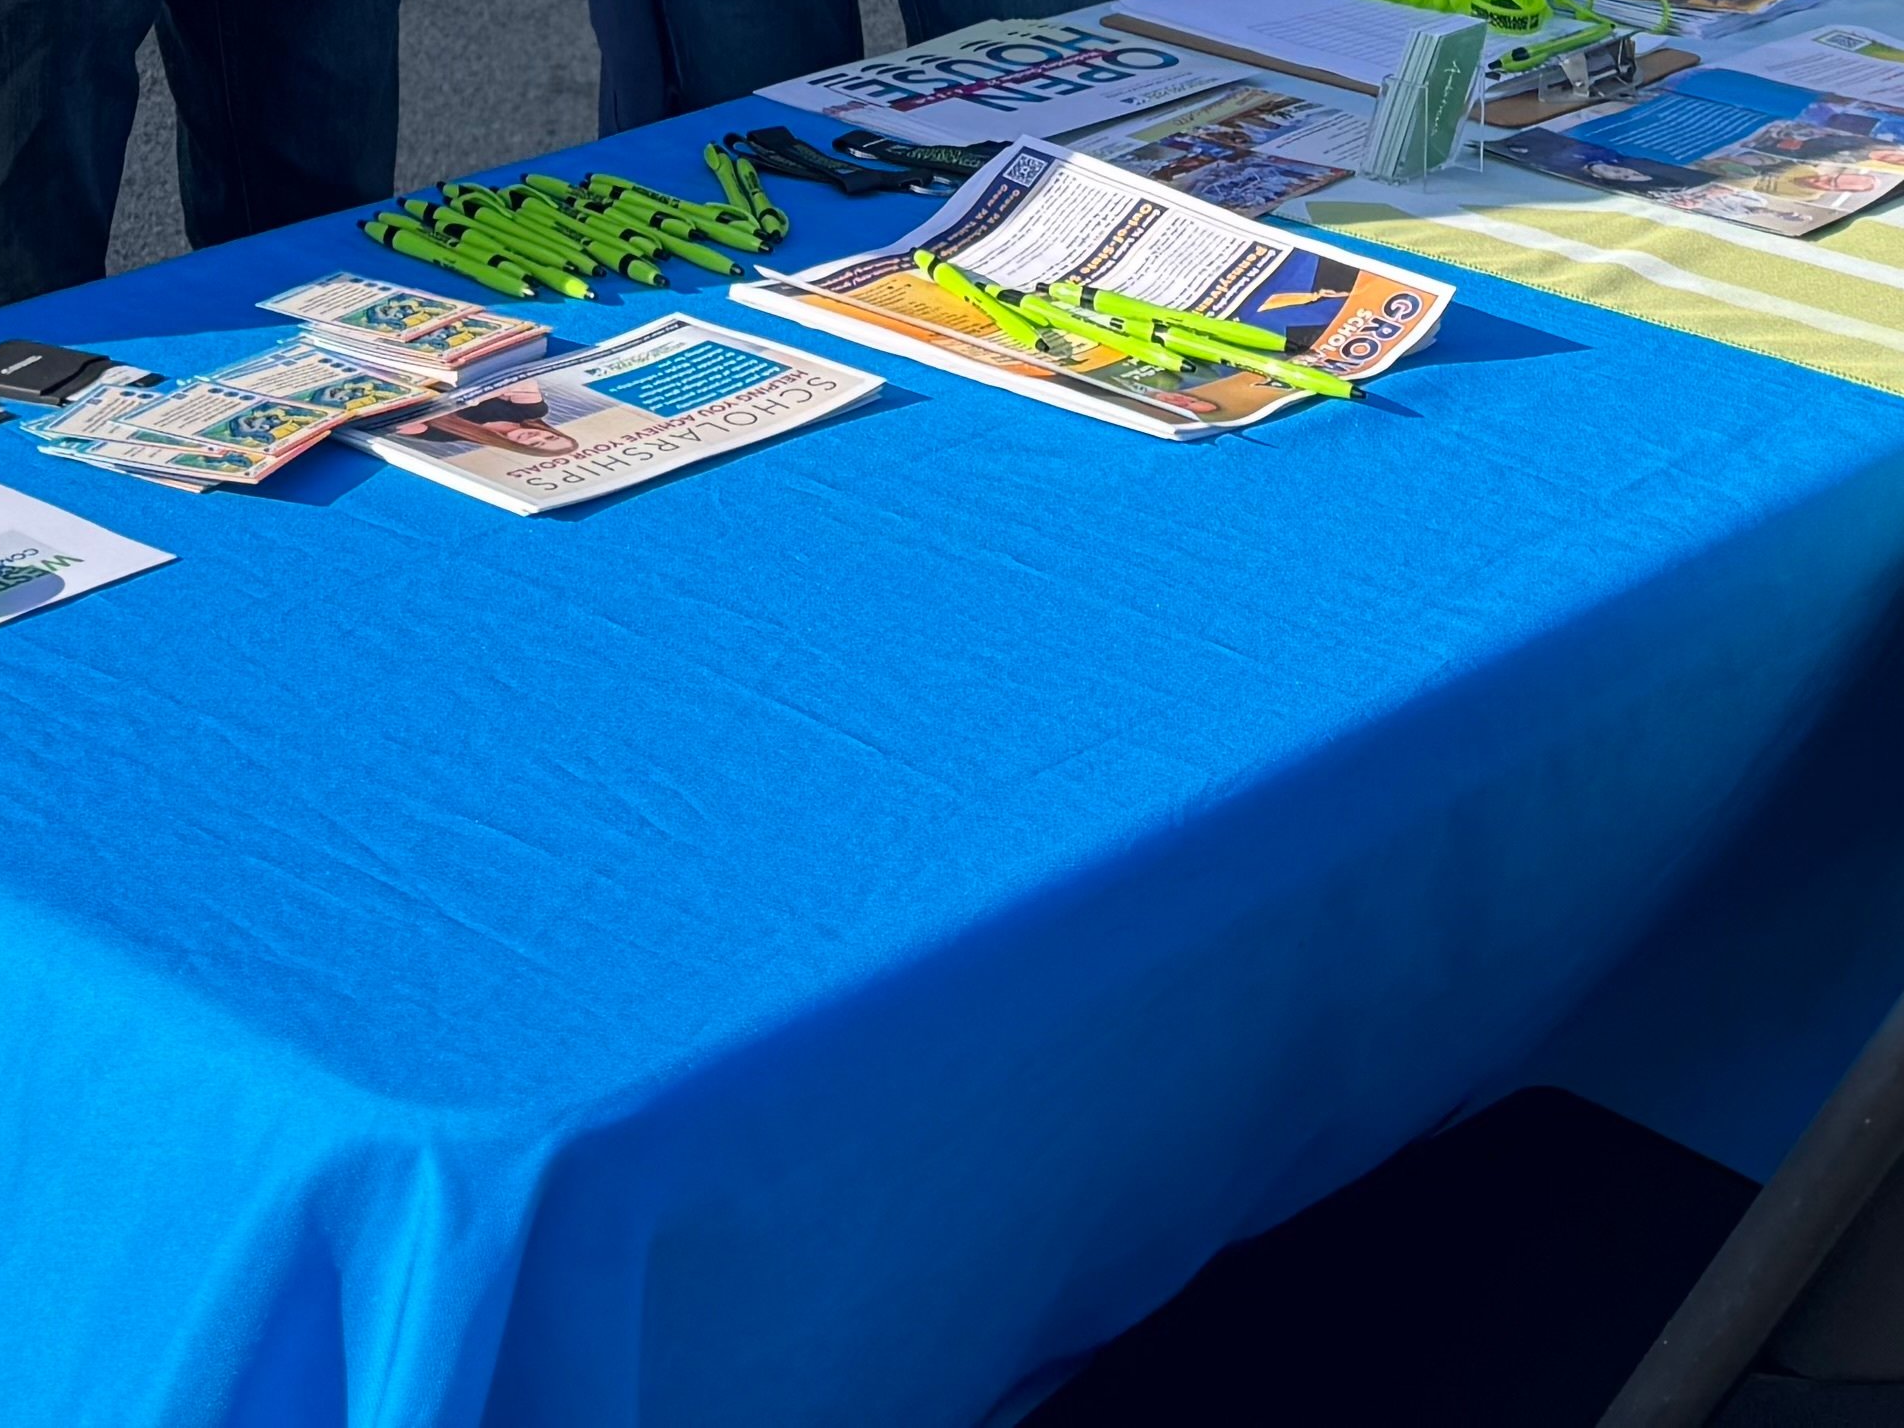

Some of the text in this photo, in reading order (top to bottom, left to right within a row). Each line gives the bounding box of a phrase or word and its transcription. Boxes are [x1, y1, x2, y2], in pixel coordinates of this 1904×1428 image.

[841, 26, 1121, 108] HOUSE
[960, 46, 1180, 112] OPEN
[1192, 245, 1268, 315] Pennsylvani
[506, 369, 809, 478] HELPING YOU ACHIEVE YOUR GOALS
[526, 376, 837, 491] SCHOLARSHIPS
